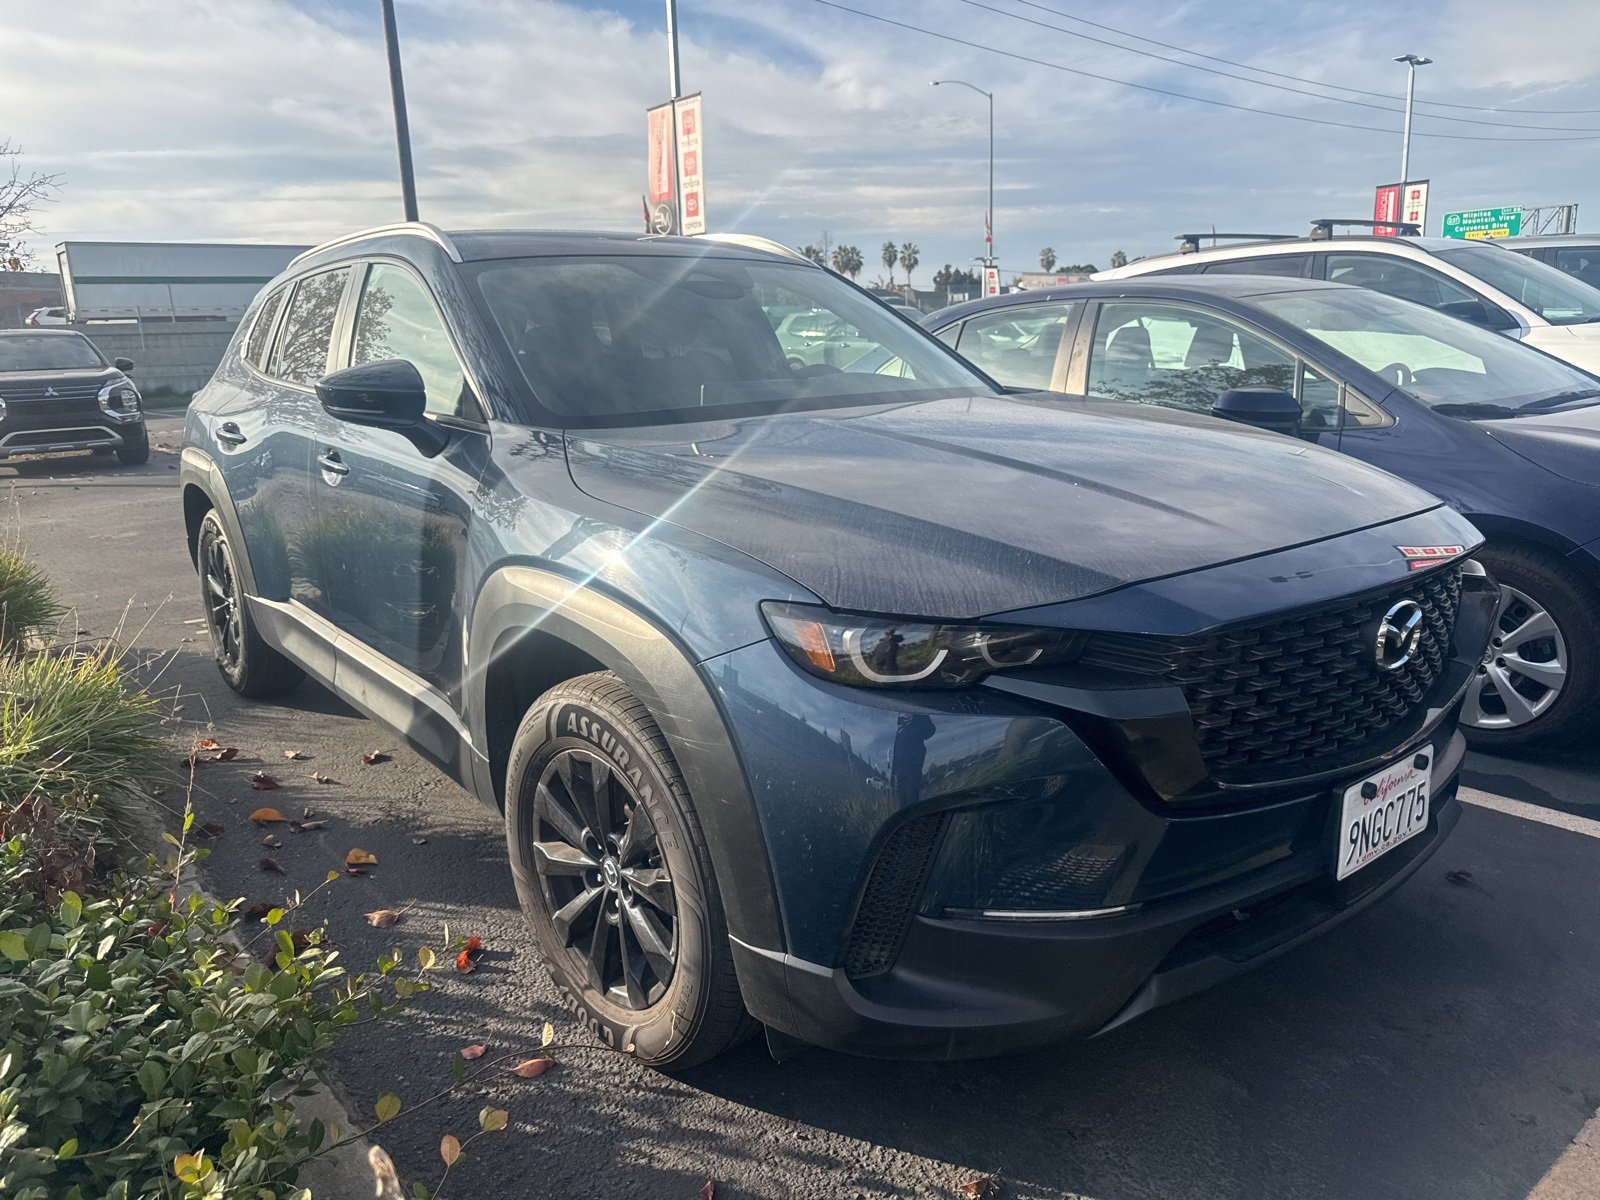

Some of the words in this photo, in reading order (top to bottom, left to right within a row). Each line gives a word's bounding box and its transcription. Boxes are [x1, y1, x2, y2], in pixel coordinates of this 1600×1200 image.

[1462, 217, 1496, 225] Mountain
[1463, 211, 1492, 219] Milpitas
[1454, 225, 1488, 233] Calaveras
[566, 711, 680, 850] ASSURANCE
[1362, 768, 1418, 806] lifornia
[1344, 780, 1427, 866] 9NGC775
